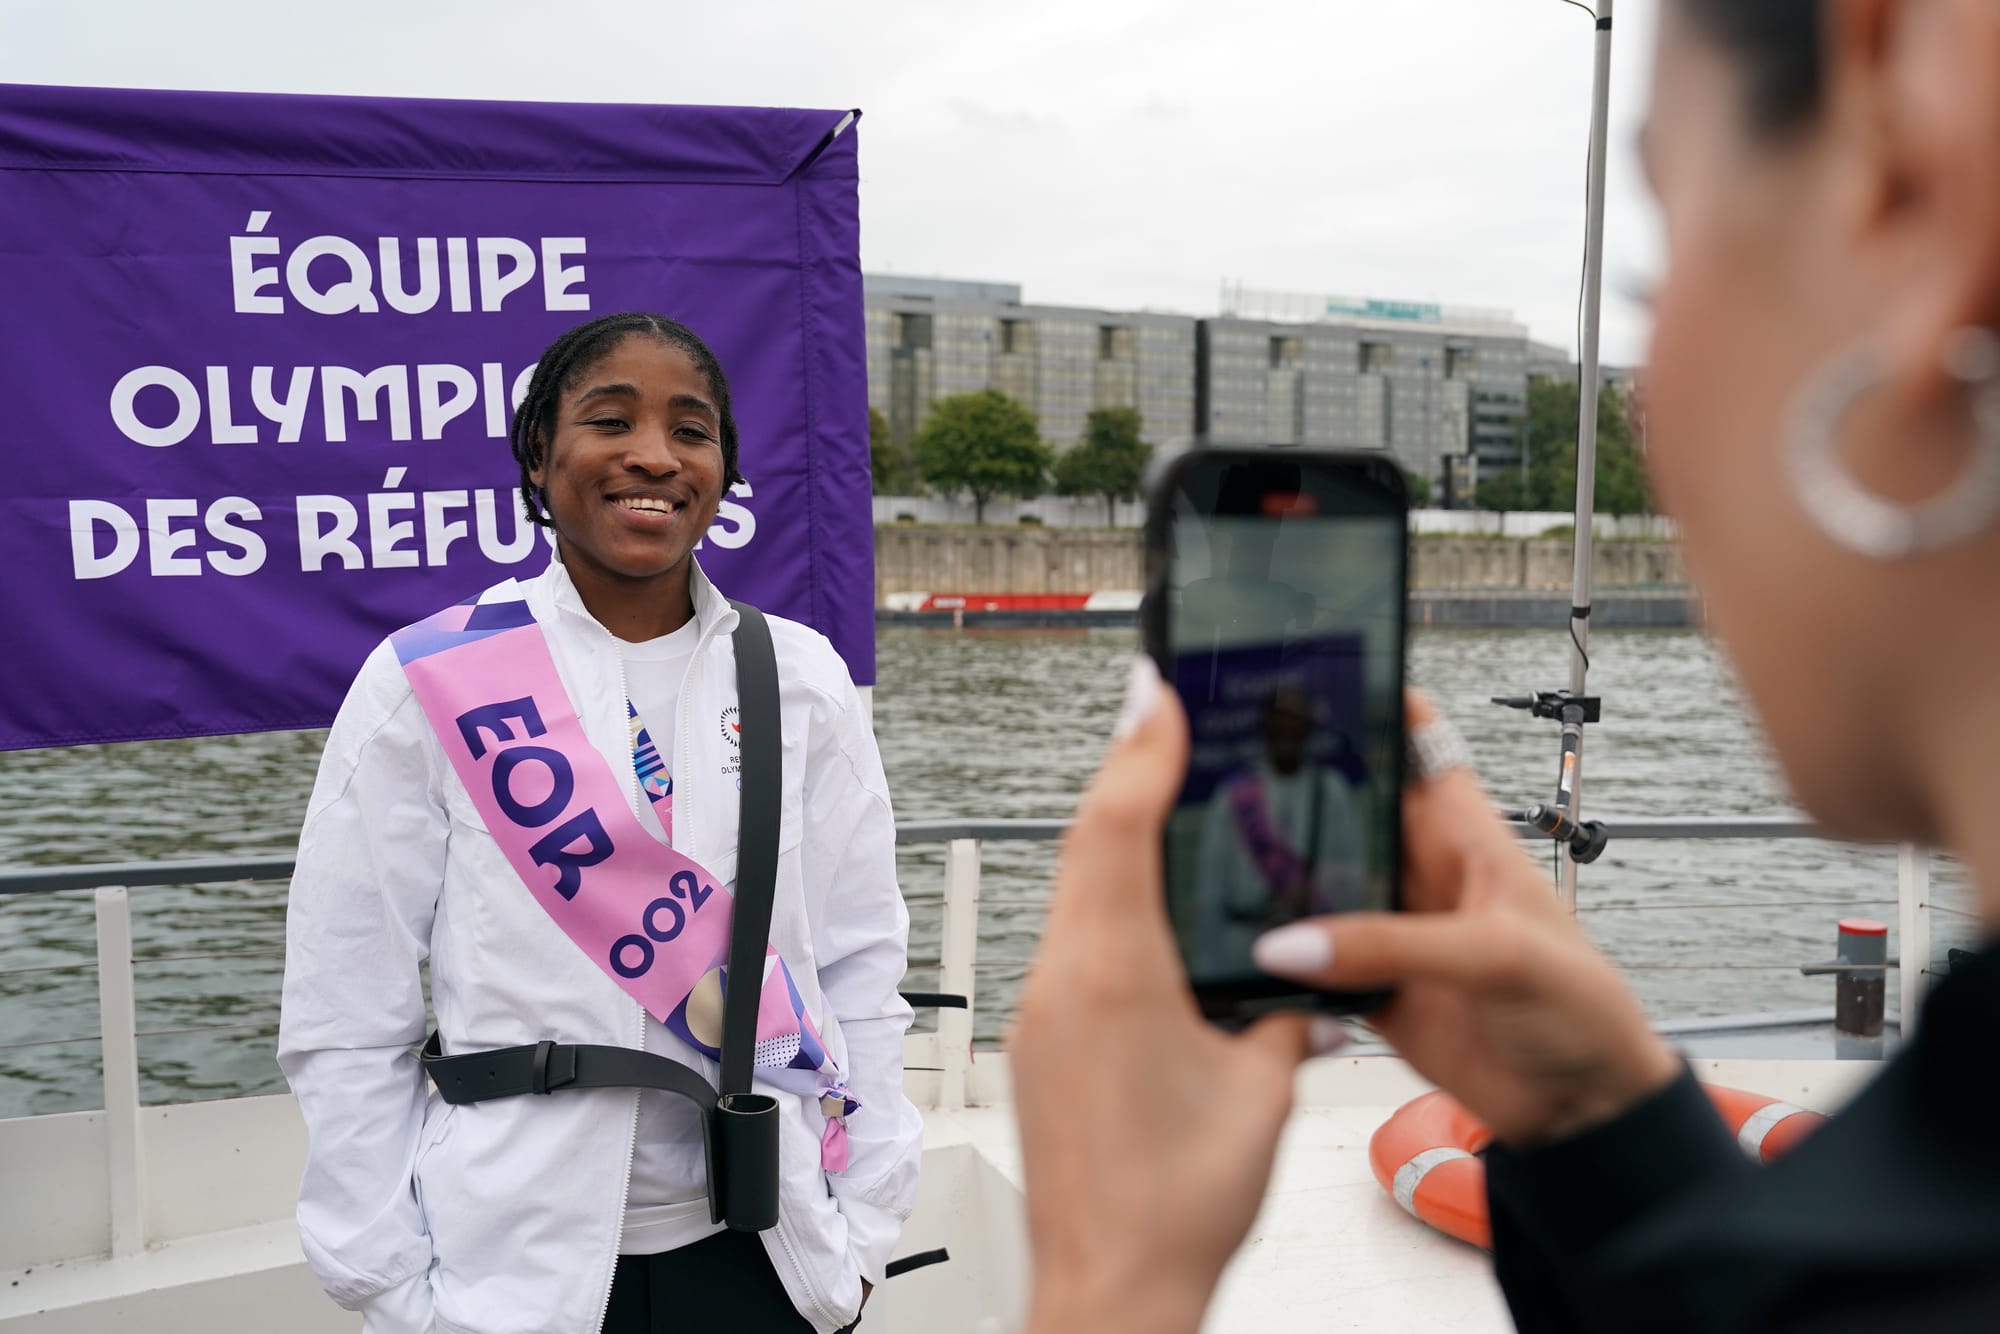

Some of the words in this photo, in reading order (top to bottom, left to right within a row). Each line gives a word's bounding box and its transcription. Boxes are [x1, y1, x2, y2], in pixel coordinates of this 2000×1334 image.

[230, 211, 591, 314] ÉQUIPE
[69, 496, 267, 580] DES
[296, 467, 757, 572] RÉFUS
[456, 696, 615, 902] EOR
[609, 870, 714, 979] 002
